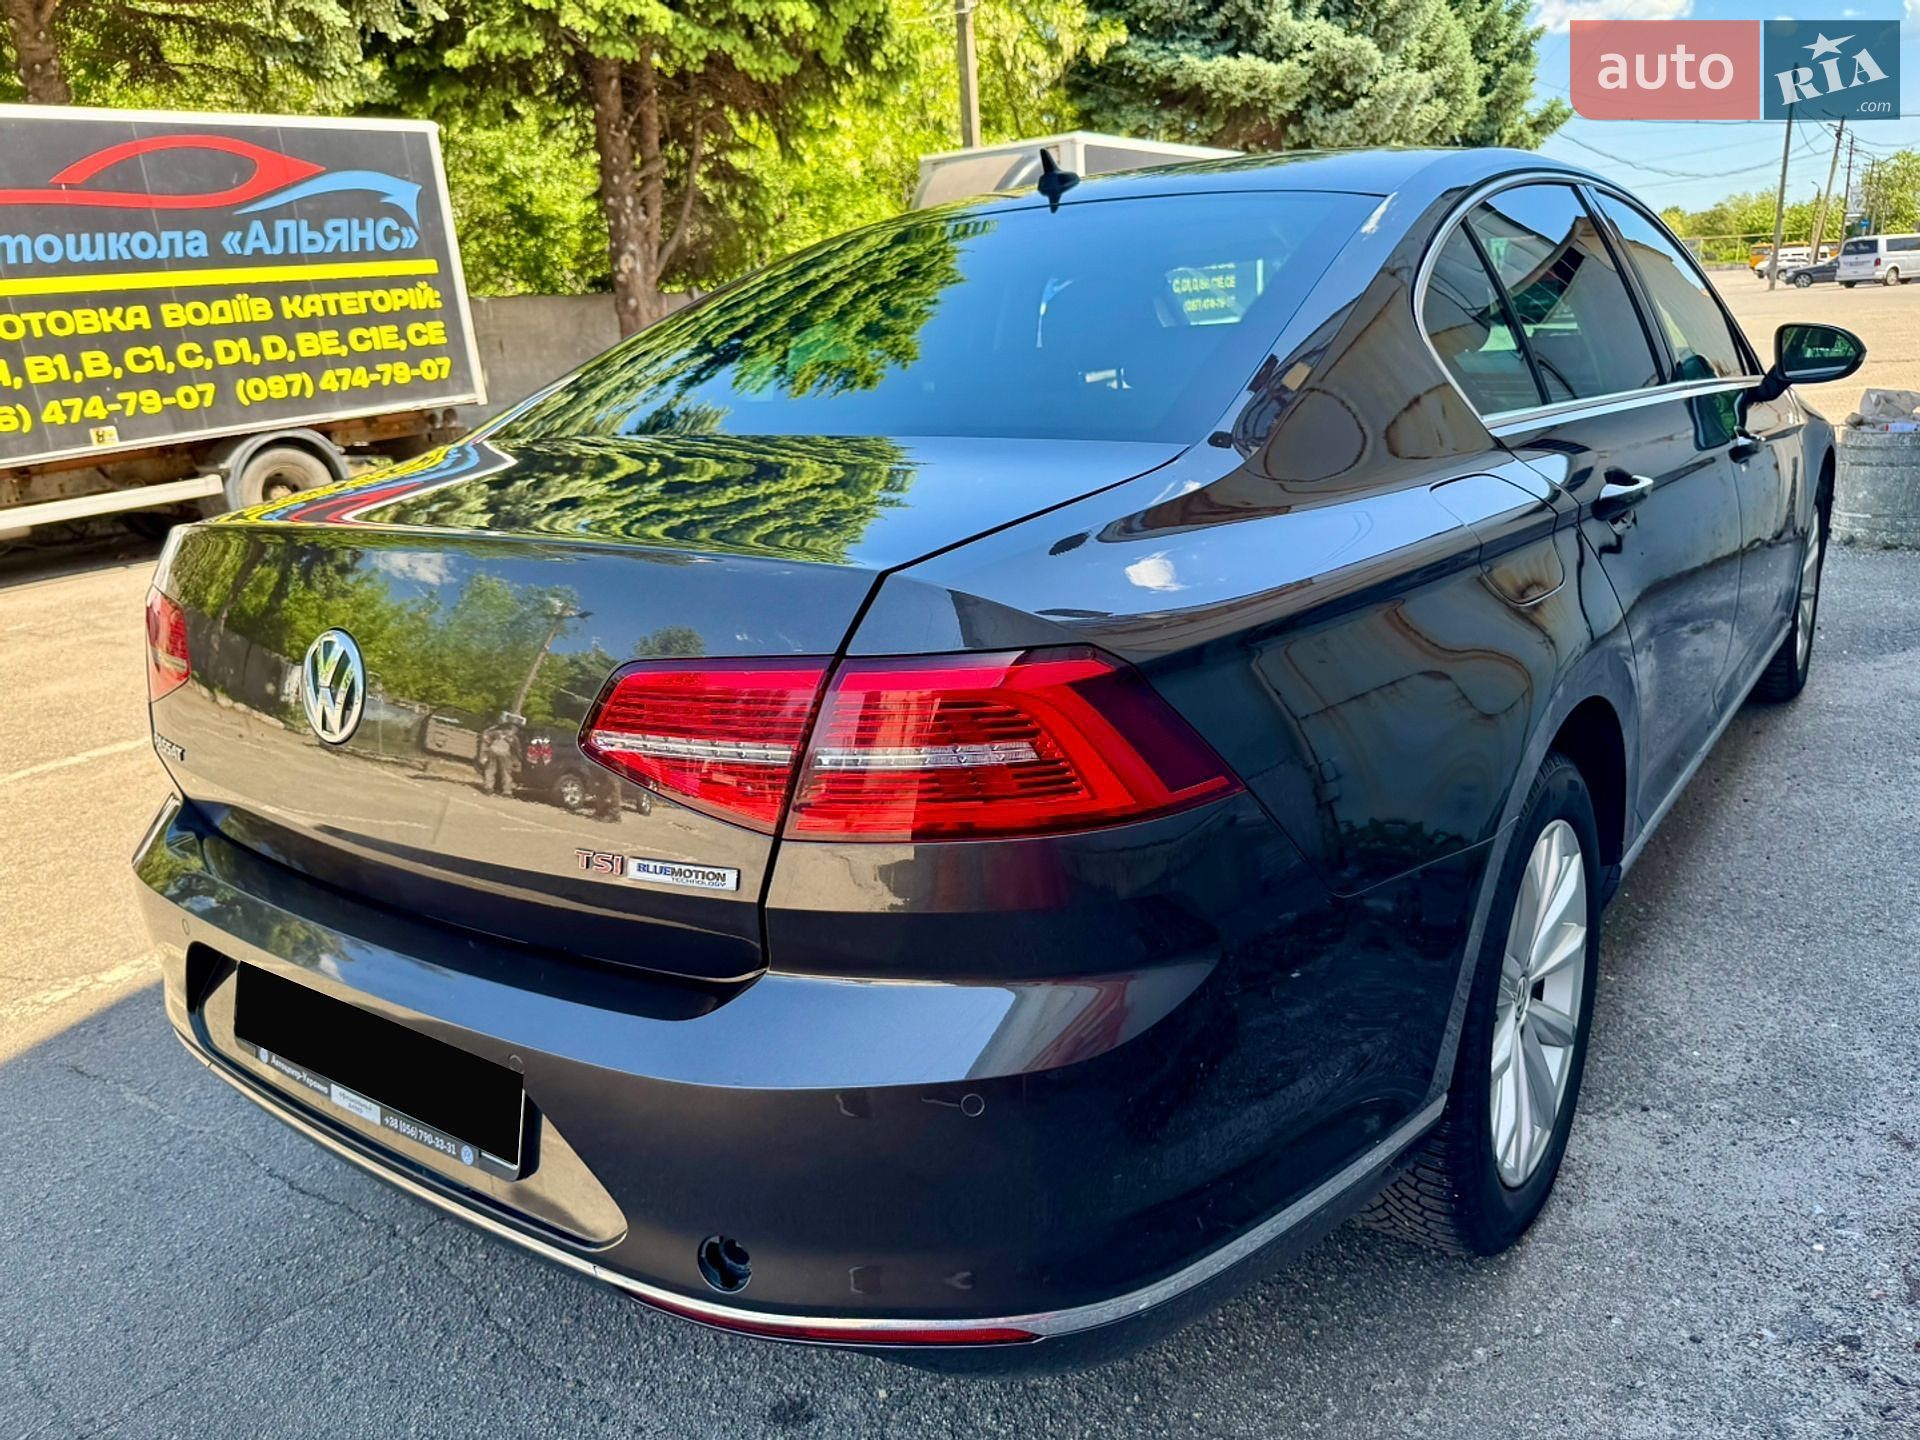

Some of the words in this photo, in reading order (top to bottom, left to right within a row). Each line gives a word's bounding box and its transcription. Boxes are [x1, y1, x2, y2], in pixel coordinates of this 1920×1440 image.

[221, 217, 419, 255] «АЛЬЯНС»
[160, 294, 274, 328] ВОДІЇВ
[280, 281, 443, 320] КАТЕГОРІЙ:
[41, 382, 215, 425] 474-79-07
[235, 371, 314, 406] (097)
[319, 356, 452, 391] 474-79-07
[575, 848, 623, 875] TSI
[637, 862, 727, 882] BLUEMOTION
[671, 876, 727, 888] TECHNOLOGY
